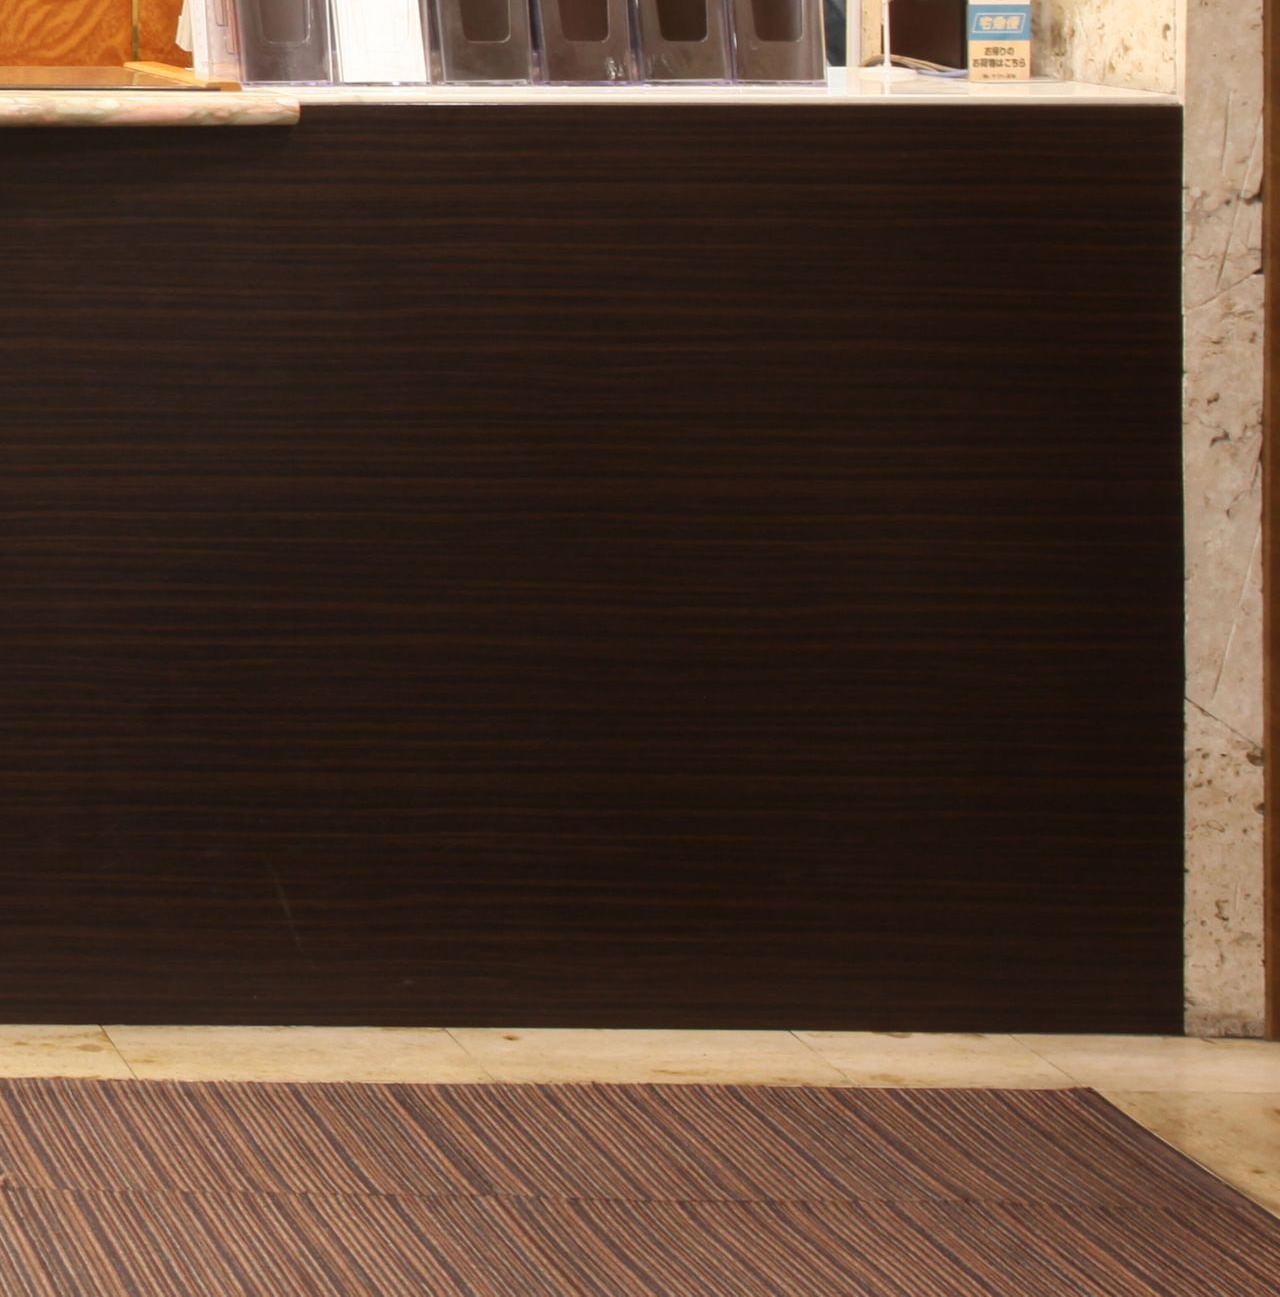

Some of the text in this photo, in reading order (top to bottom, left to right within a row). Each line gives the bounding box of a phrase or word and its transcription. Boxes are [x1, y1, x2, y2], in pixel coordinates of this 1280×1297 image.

[979, 15, 1021, 31] 宅急便
[984, 46, 1015, 56] お帰りの
[972, 58, 1026, 68] お荷物はこちら
